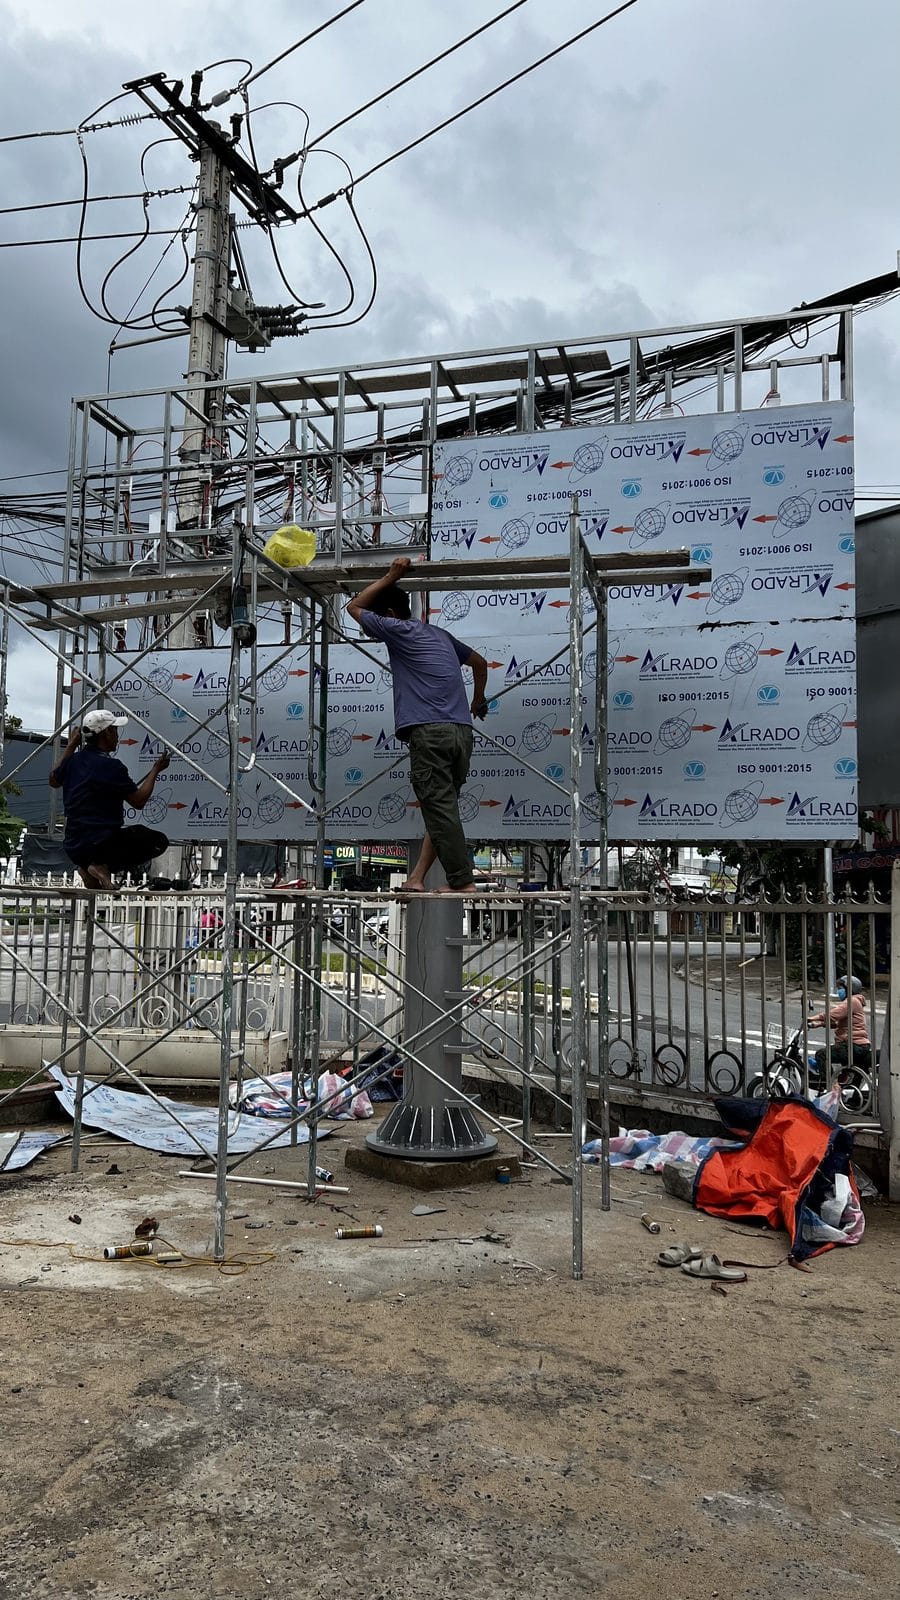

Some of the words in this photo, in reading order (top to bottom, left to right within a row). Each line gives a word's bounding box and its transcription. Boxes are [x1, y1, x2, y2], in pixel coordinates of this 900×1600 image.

[751, 426, 831, 451] ALRADO
[610, 440, 686, 464] ALRADO
[479, 453, 550, 476] ALRADO
[661, 478, 711, 490] 9001:2015
[713, 476, 732, 487] ISO
[526, 490, 572, 502] 9001:2015
[446, 500, 462, 509] ISO
[672, 506, 749, 530] ALRADO
[536, 516, 609, 541] ALADO
[739, 545, 791, 557] 9001:2015
[793, 543, 812, 553] ISO
[751, 573, 833, 597] ALRADO
[476, 591, 547, 614] ALRADO
[639, 649, 718, 673] ALRADO
[658, 693, 676, 702] ISO
[679, 691, 730, 701] 9001:2015
[806, 688, 825, 697] ISO
[522, 698, 539, 707] ISO
[541, 696, 588, 706] 9001:25
[327, 705, 340, 713] SO
[342, 704, 385, 712] 9001:2015
[580, 723, 653, 746] ARADO
[717, 717, 800, 743] ALRADO
[473, 735, 516, 748] RADO
[389, 771, 405, 779] ISO
[480, 769, 525, 778] 9001:2015
[614, 766, 663, 776] 9001:2015
[737, 765, 756, 774] ISO
[759, 764, 812, 773] 9001:2015
[155, 774, 167, 782] SO
[638, 793, 718, 817] ALRADO
